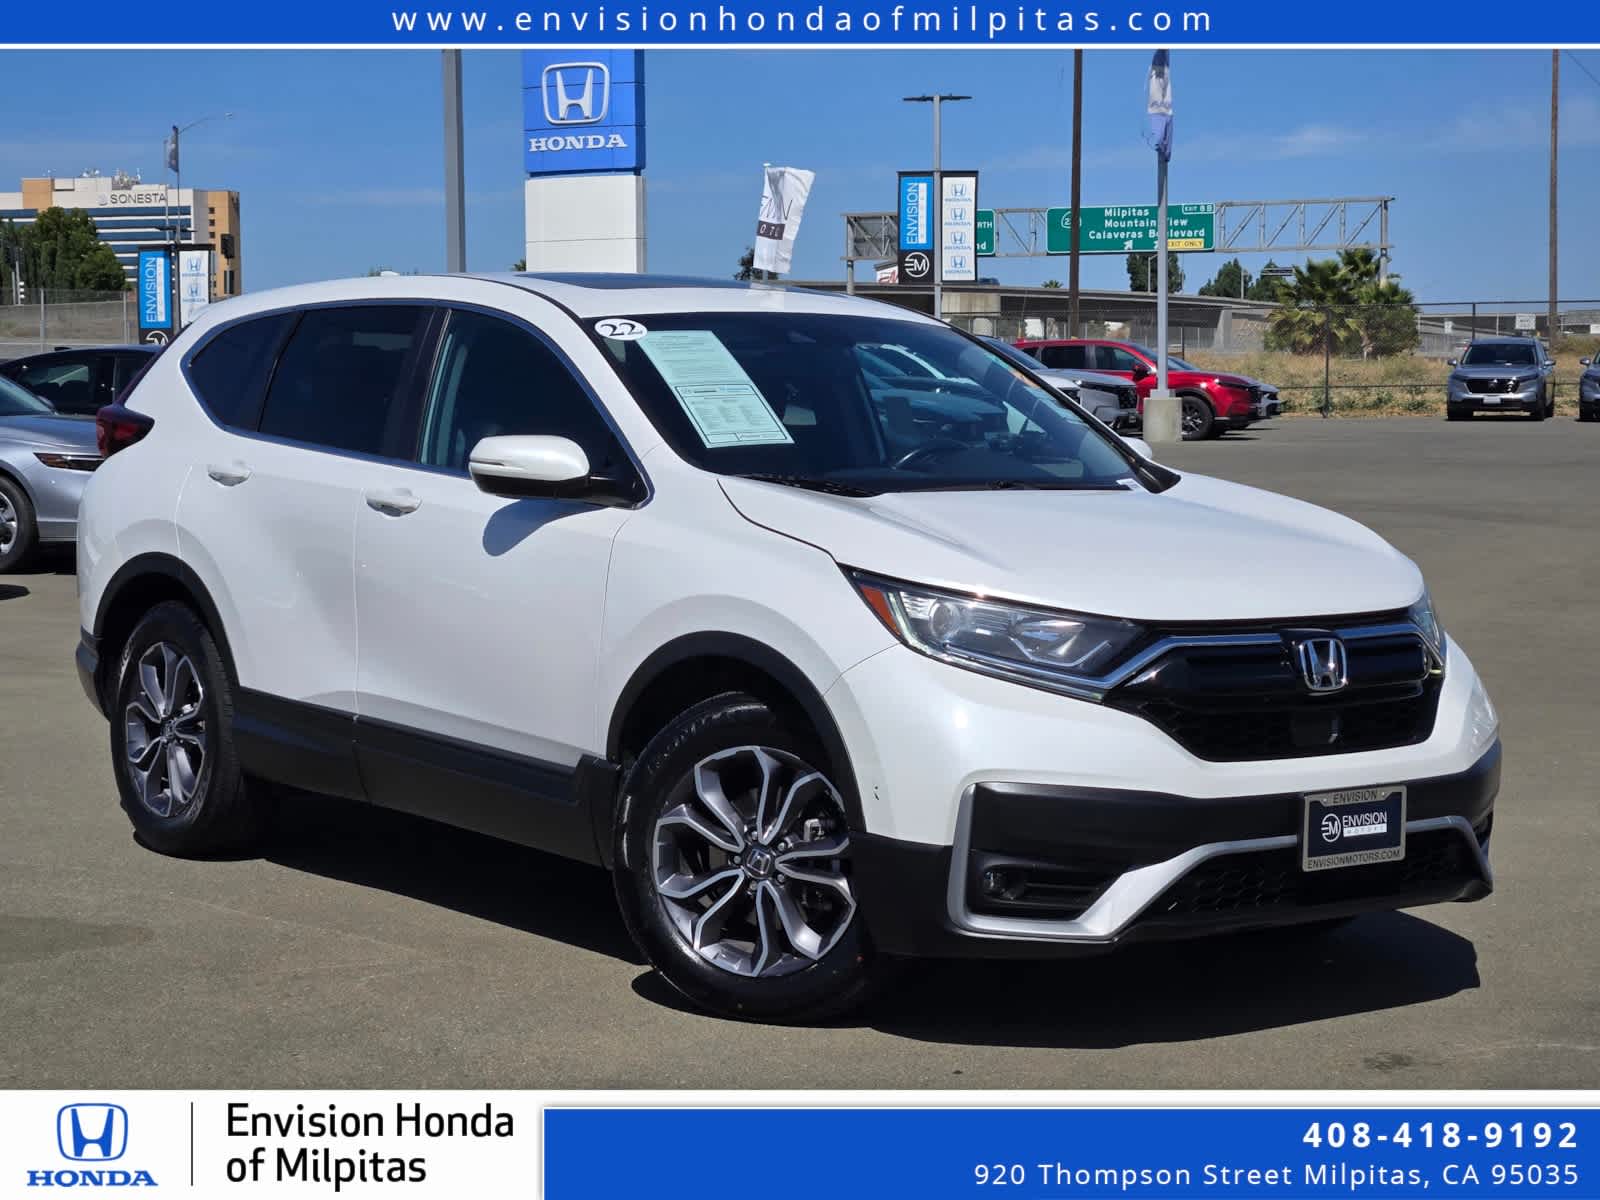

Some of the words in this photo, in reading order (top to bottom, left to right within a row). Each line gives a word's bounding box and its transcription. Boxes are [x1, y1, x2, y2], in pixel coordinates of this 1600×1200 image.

[529, 134, 628, 152] HONDA
[110, 193, 167, 204] SONESTA
[907, 182, 919, 244] ENVISION
[1104, 207, 1150, 218] Milpitas
[1104, 217, 1157, 228] Mountain
[1167, 216, 1189, 227] iew
[1088, 229, 1143, 239] Calaveras
[146, 256, 157, 322] ENVISION
[600, 322, 643, 336] 22
[1333, 790, 1378, 804] ENVISION
[1342, 811, 1388, 827] ENVISION
[1307, 849, 1401, 869] ENVISIONMOTORS.COM
